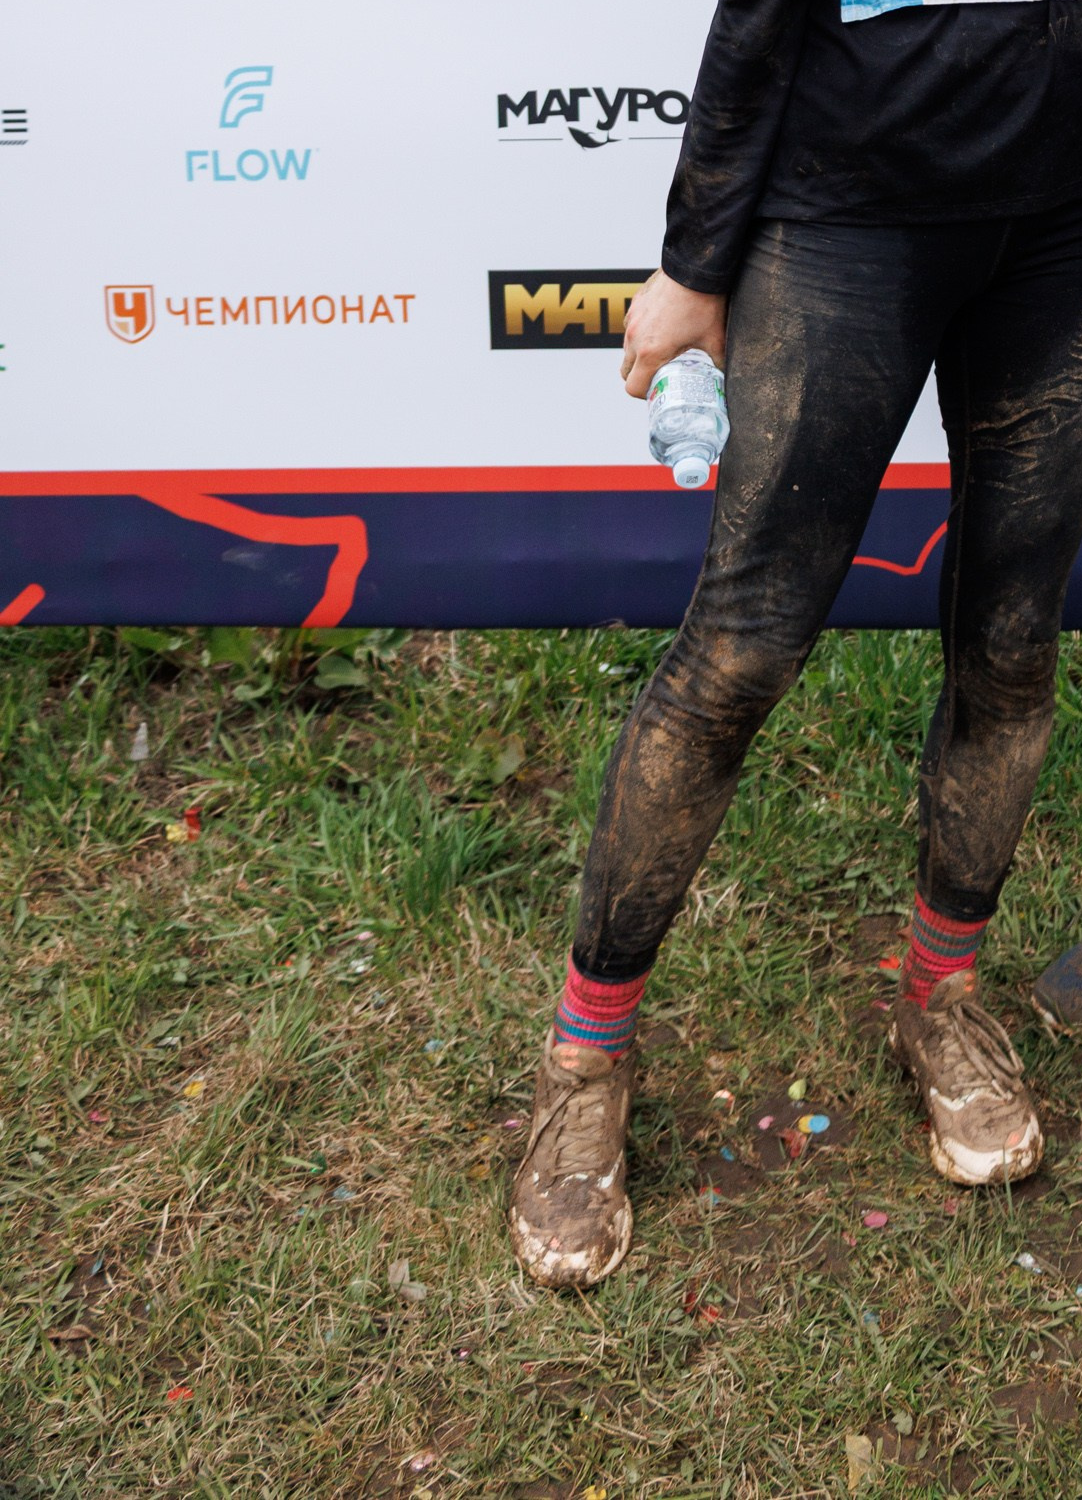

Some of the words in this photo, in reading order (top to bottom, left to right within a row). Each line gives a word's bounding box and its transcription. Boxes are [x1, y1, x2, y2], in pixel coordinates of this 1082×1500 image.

[497, 87, 690, 131] МАГУРО
[185, 148, 312, 182] FLOW
[165, 293, 417, 327] ЧЕМПИОНАТ
[504, 282, 645, 336] МАТ
